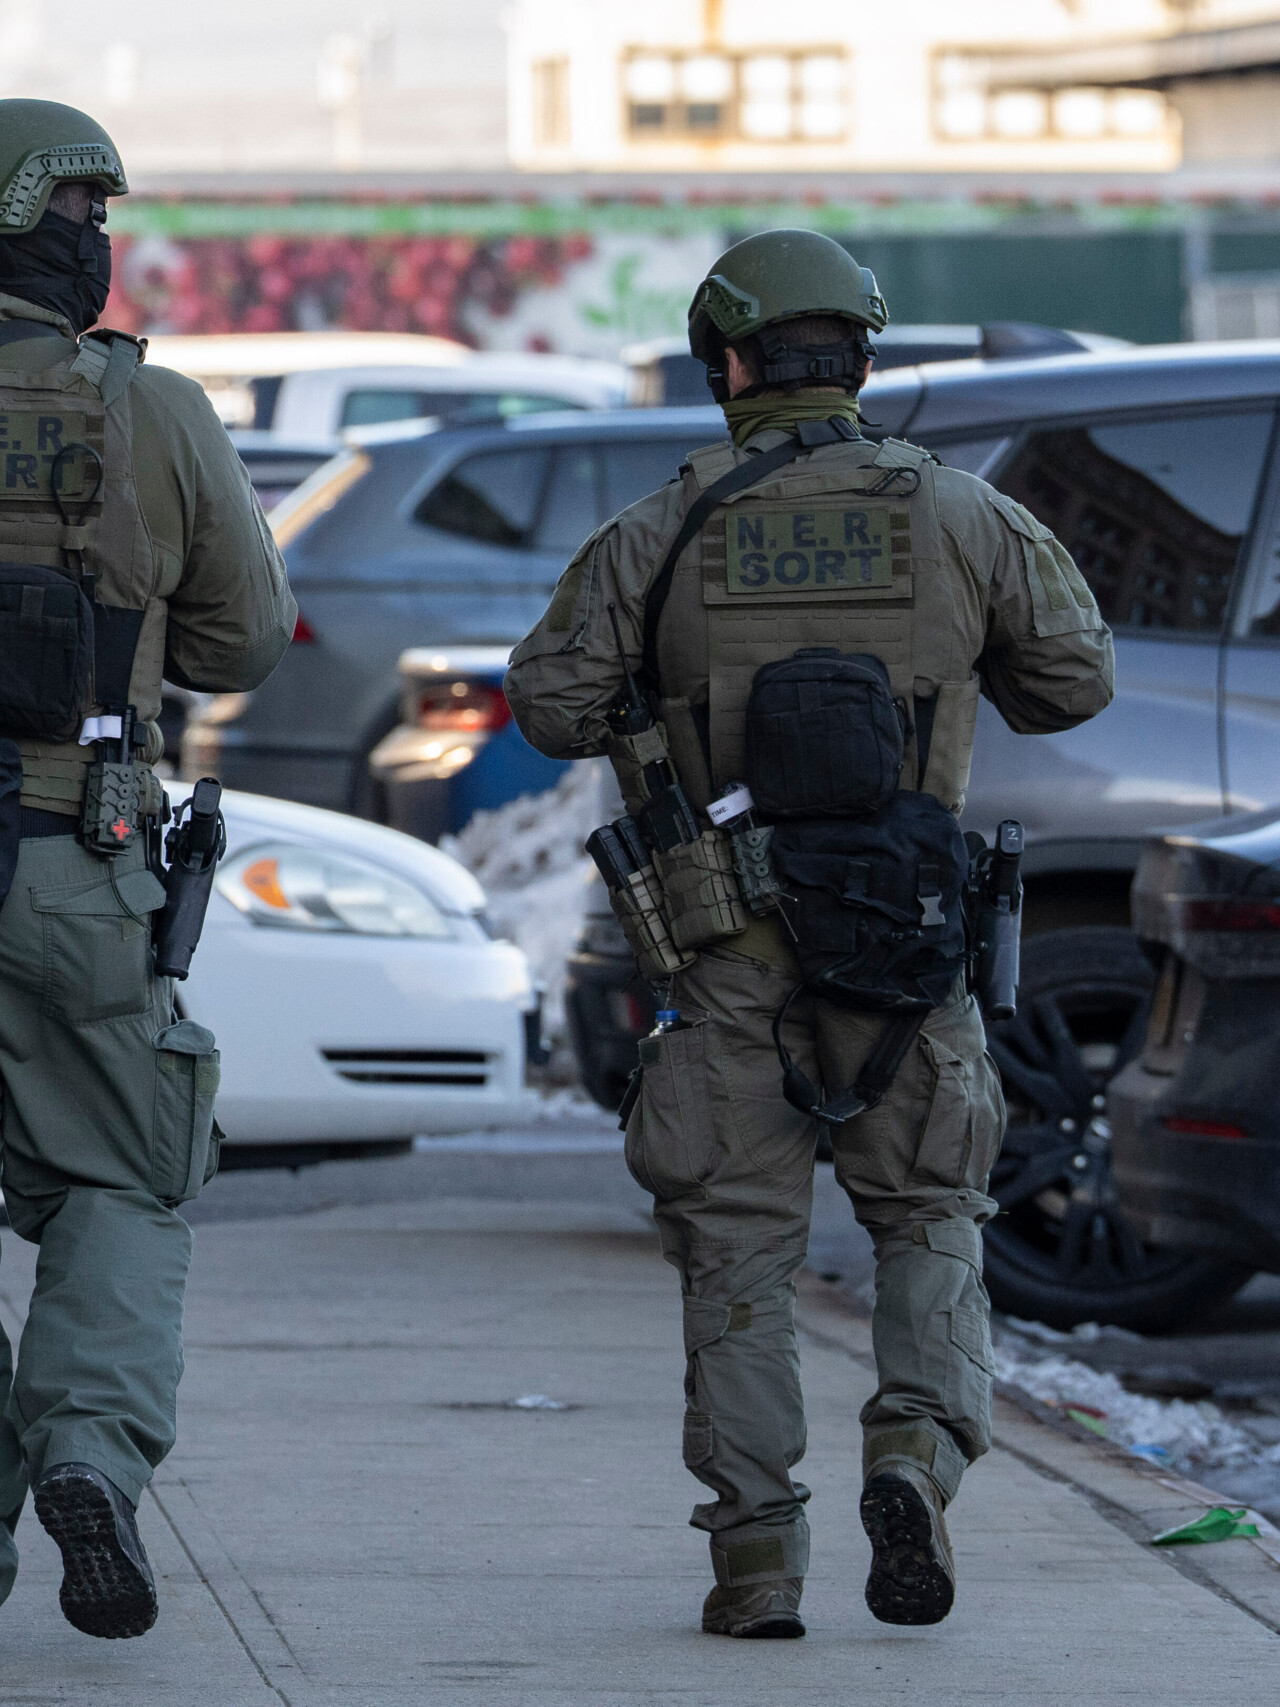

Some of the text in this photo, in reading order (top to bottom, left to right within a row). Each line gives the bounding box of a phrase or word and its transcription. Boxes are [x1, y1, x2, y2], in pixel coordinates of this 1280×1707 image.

[737, 511, 882, 550] N. E. R.
[738, 548, 882, 587] SORT
[711, 805, 729, 818] TIME:
